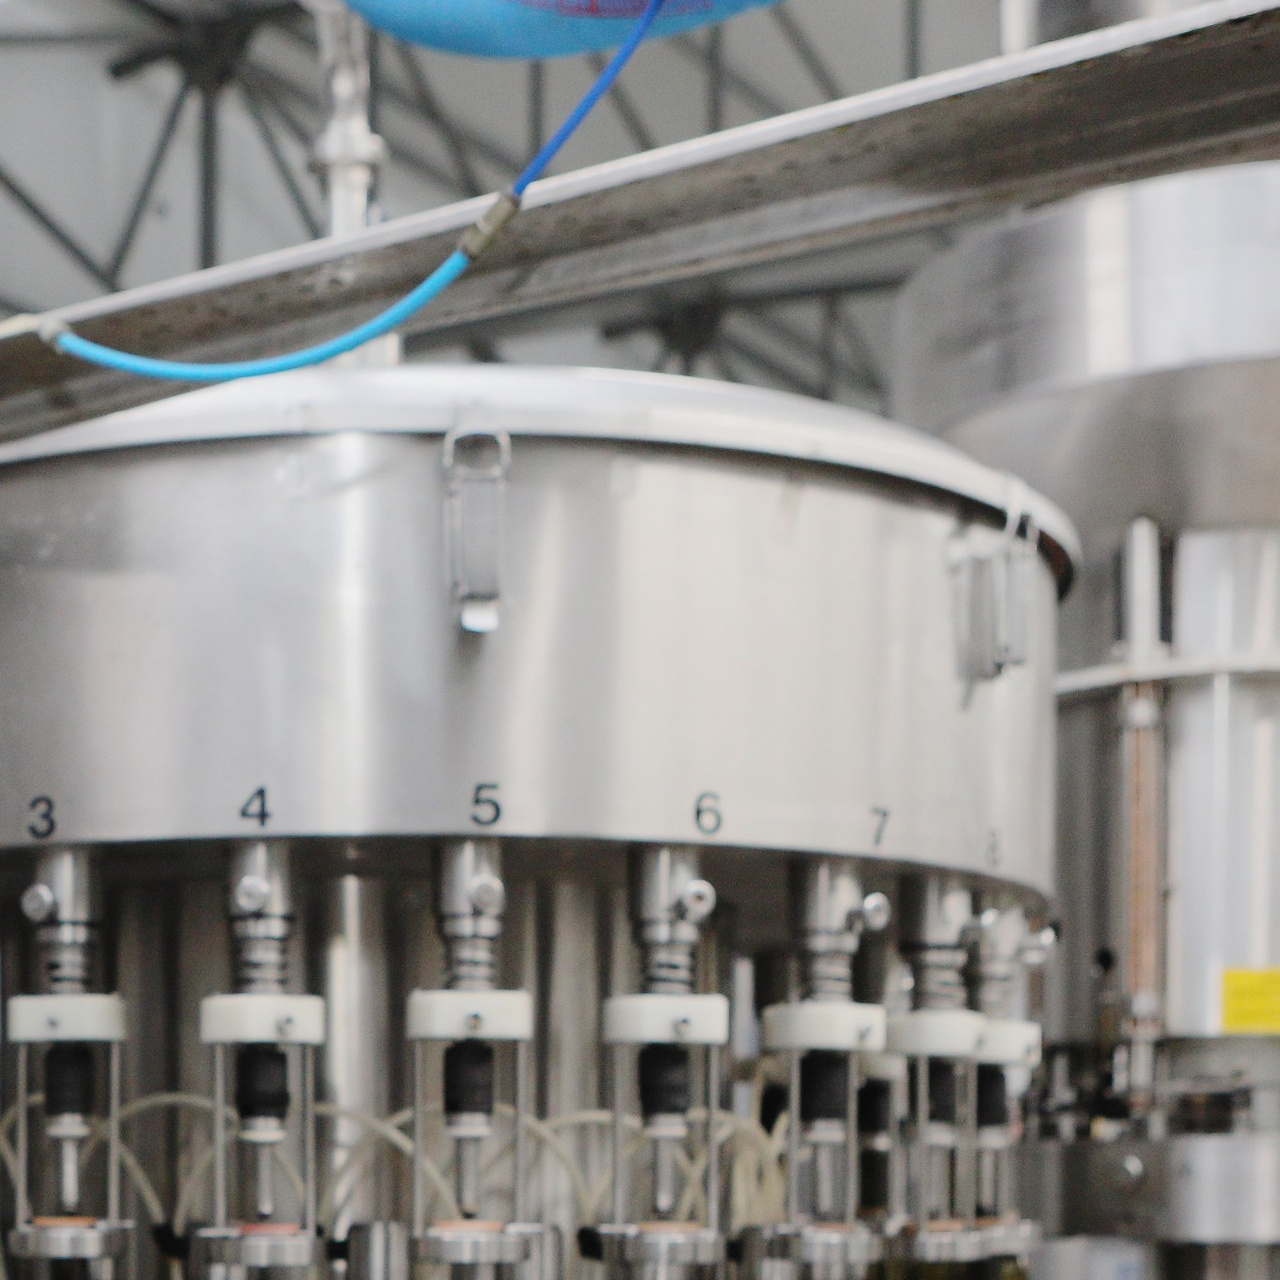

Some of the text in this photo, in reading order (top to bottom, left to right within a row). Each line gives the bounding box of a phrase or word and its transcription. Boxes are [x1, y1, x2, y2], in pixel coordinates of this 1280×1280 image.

[27, 795, 56, 840] 3
[239, 785, 272, 827] 4
[471, 783, 502, 826] 5
[695, 791, 723, 835] 6
[870, 806, 889, 846] 7
